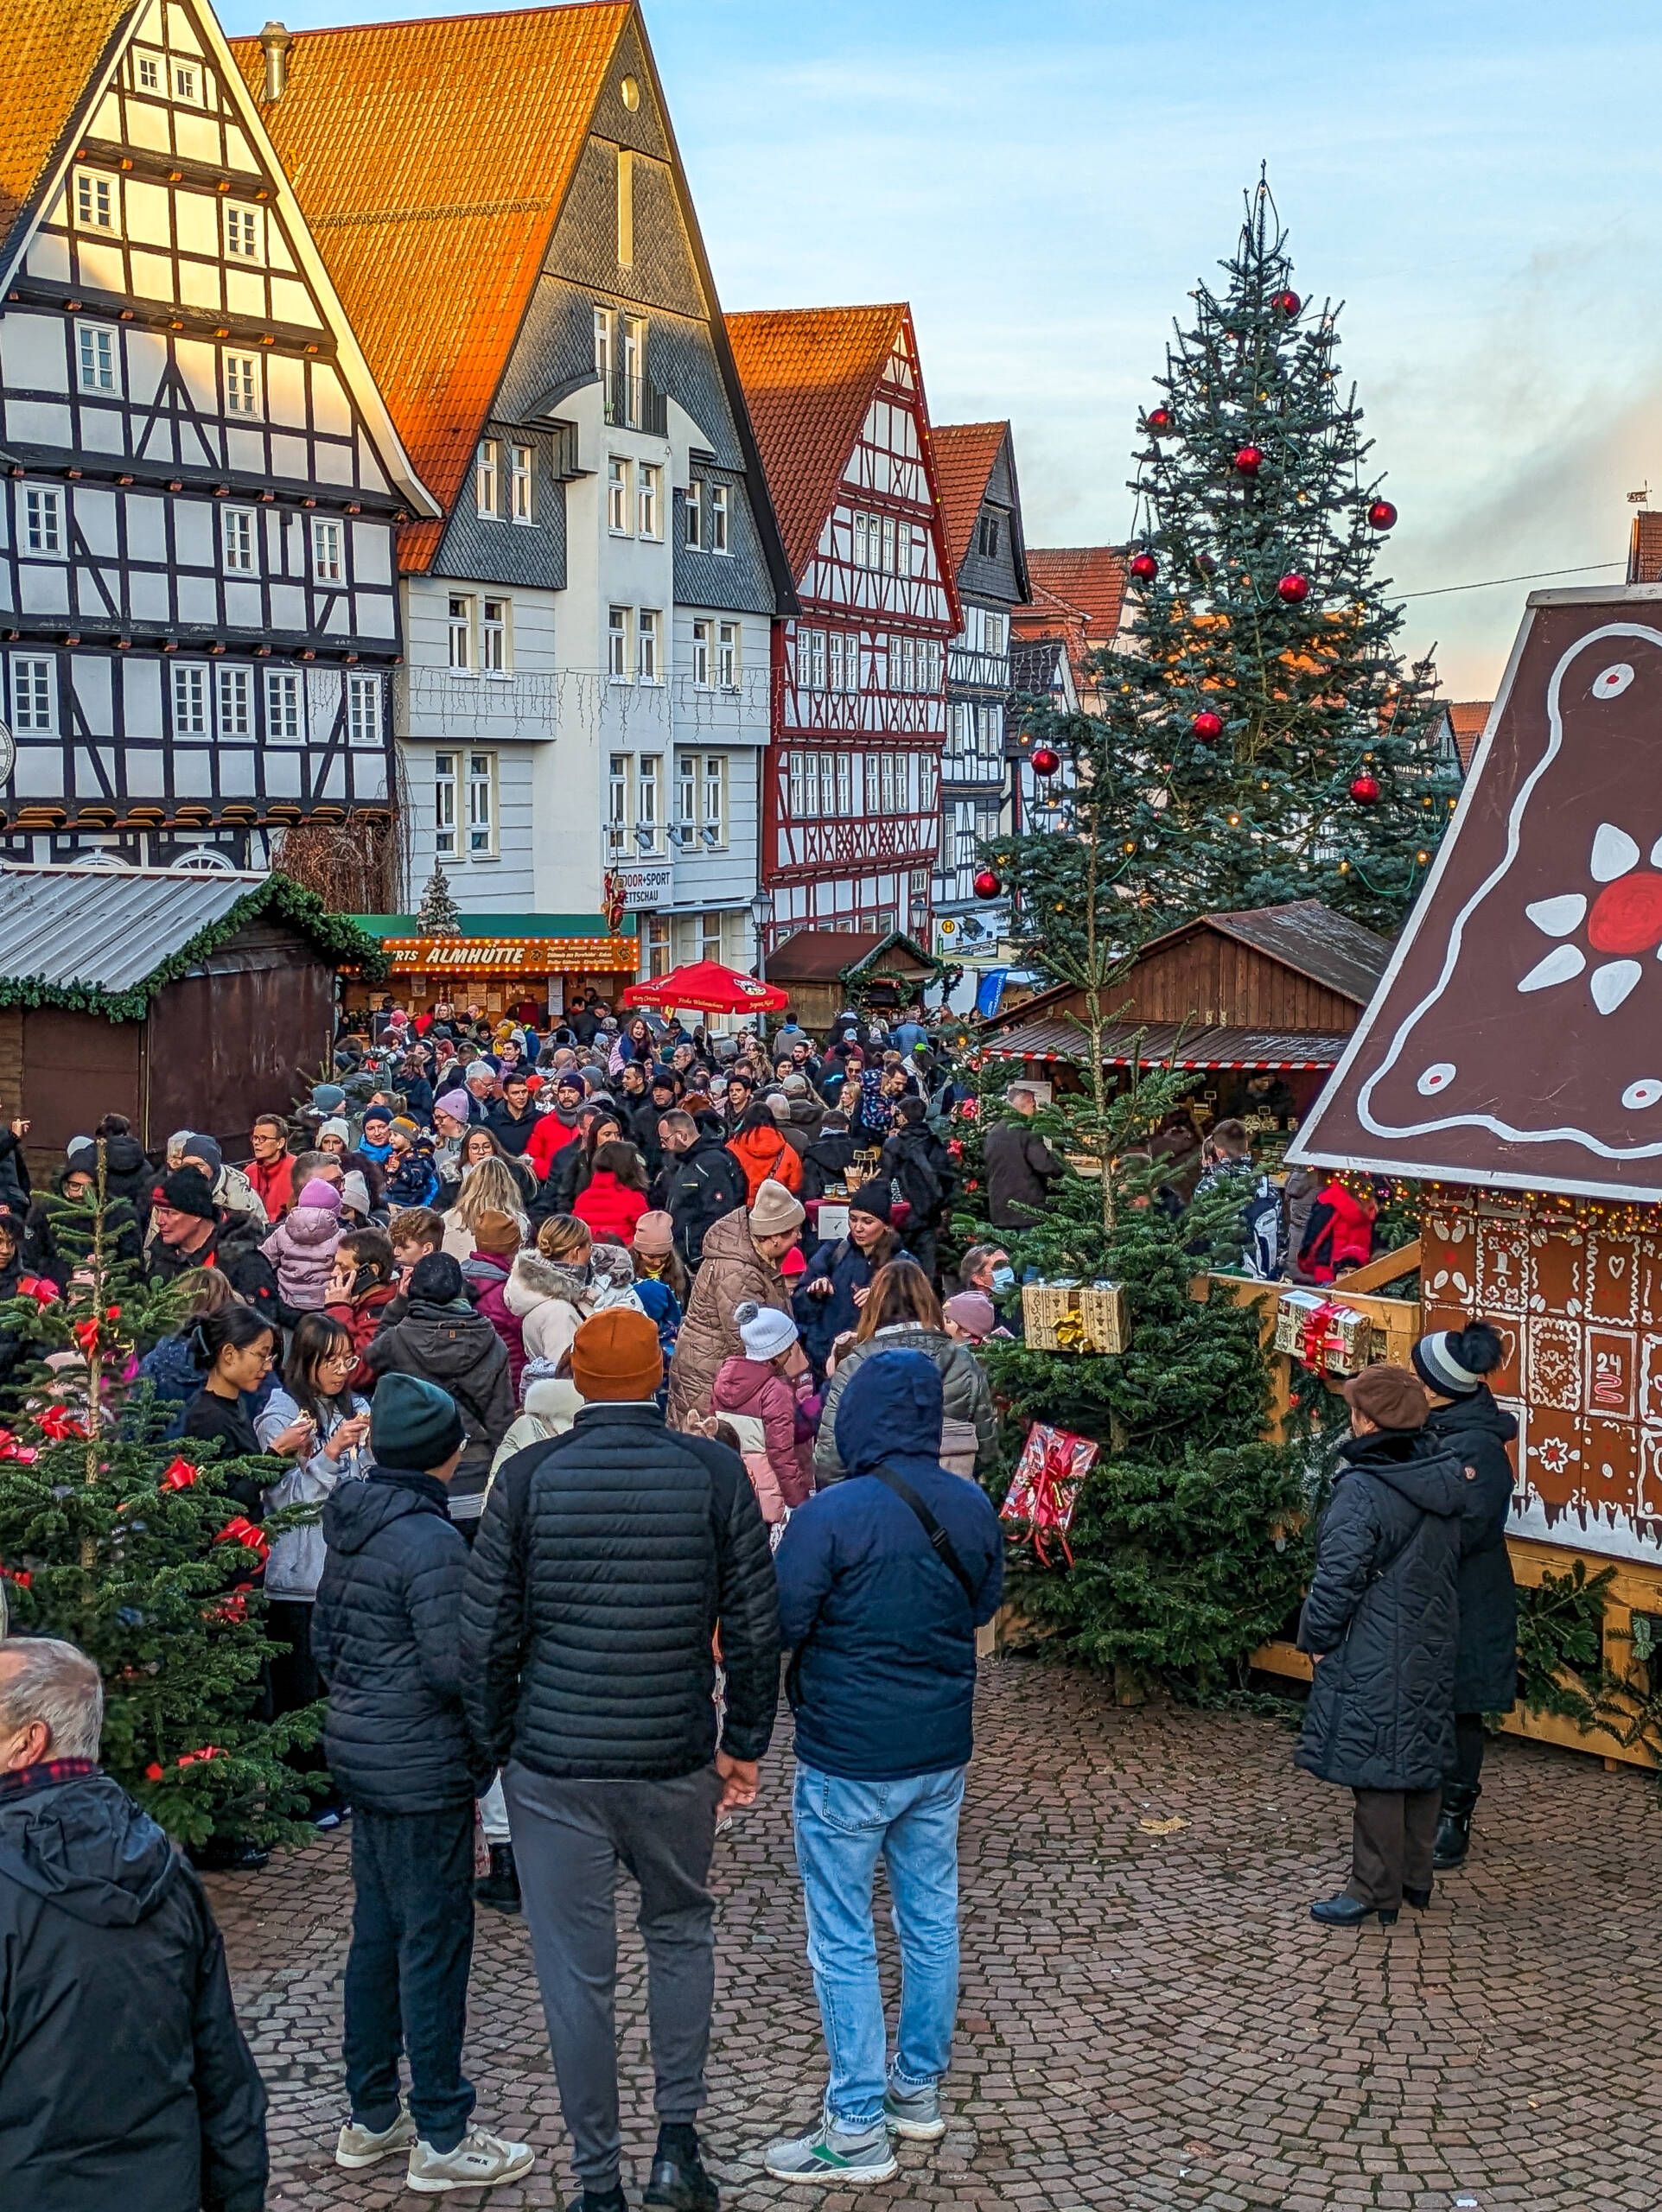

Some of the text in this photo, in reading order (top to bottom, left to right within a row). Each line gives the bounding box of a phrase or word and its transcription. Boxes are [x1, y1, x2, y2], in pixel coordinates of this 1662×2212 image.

[620, 872, 671, 887] DOOR+SPORT
[625, 890, 659, 904] ETTSCHAU
[425, 944, 526, 964] ALMHÜTTE
[1595, 1352, 1621, 1376] 24
